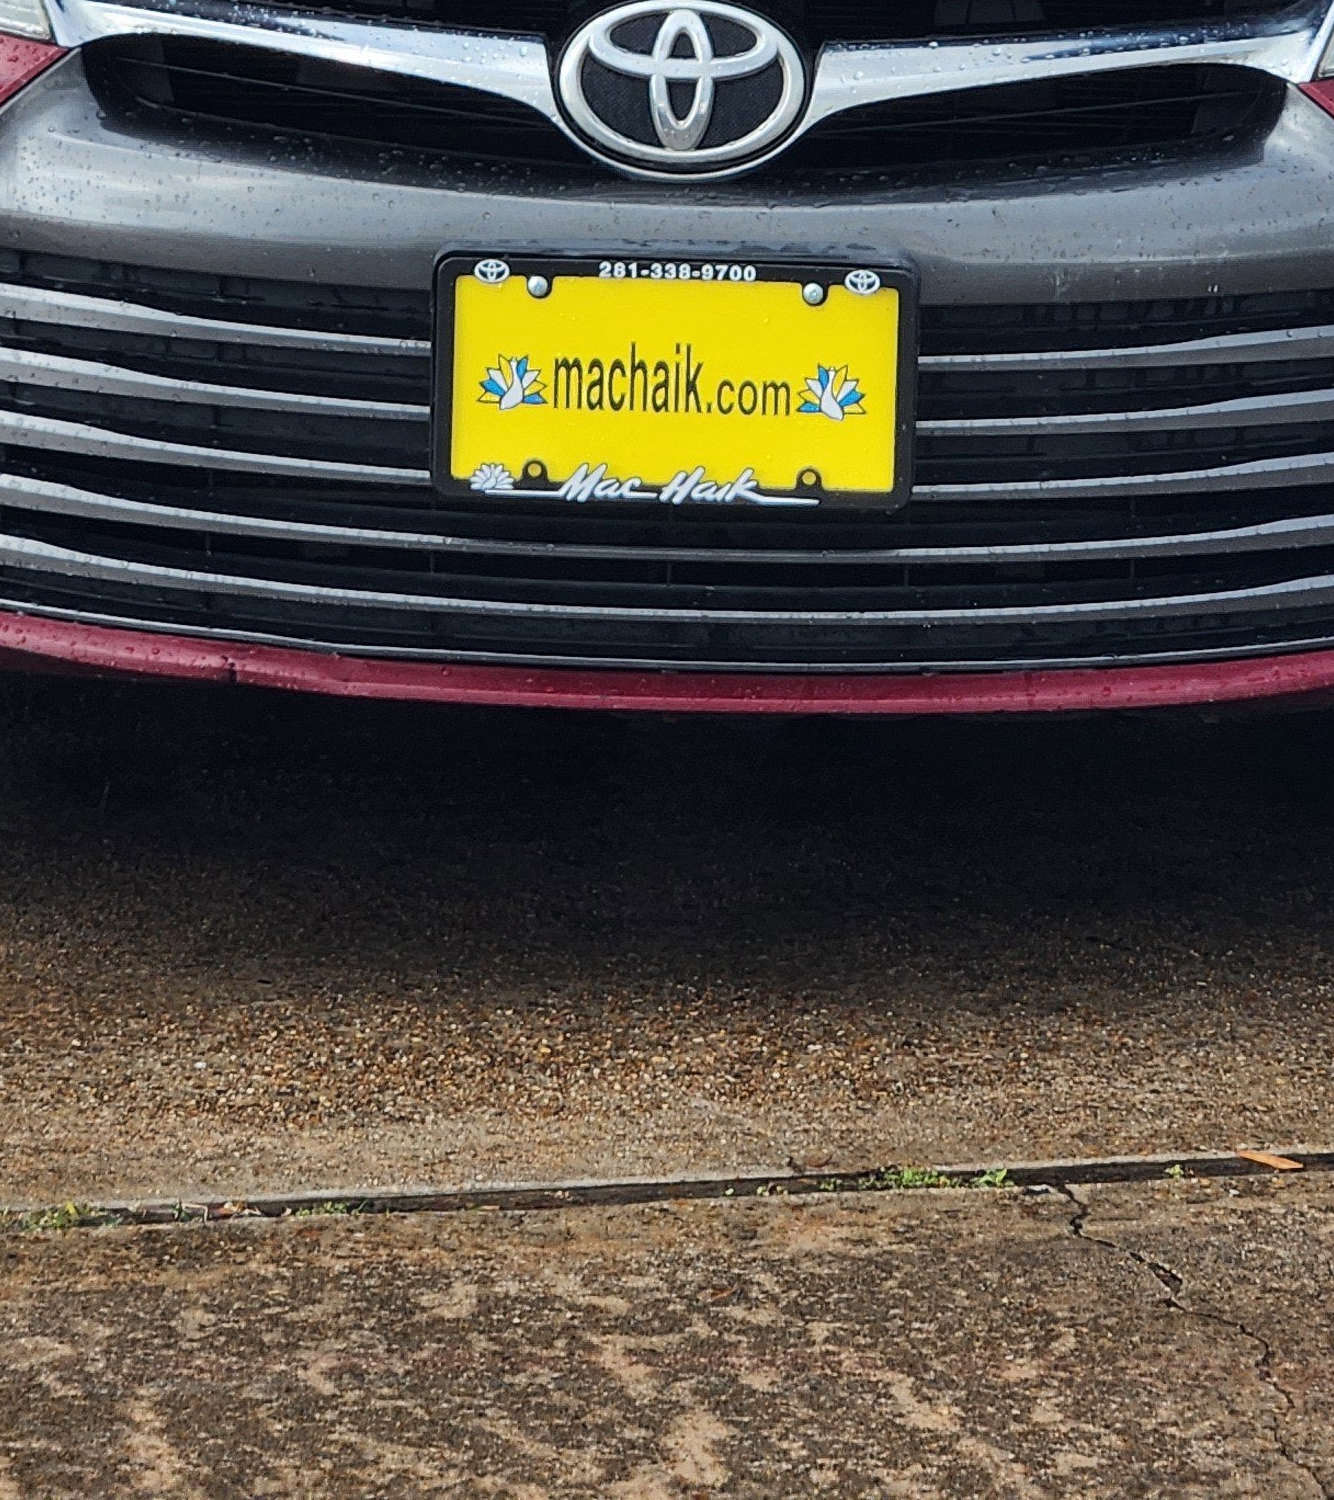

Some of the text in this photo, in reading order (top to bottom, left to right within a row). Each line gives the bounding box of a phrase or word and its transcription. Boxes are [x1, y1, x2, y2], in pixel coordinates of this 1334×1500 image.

[598, 260, 757, 281] 281-338-9700
[553, 341, 791, 416] machaik.com
[559, 462, 767, 506] Mac Haik
